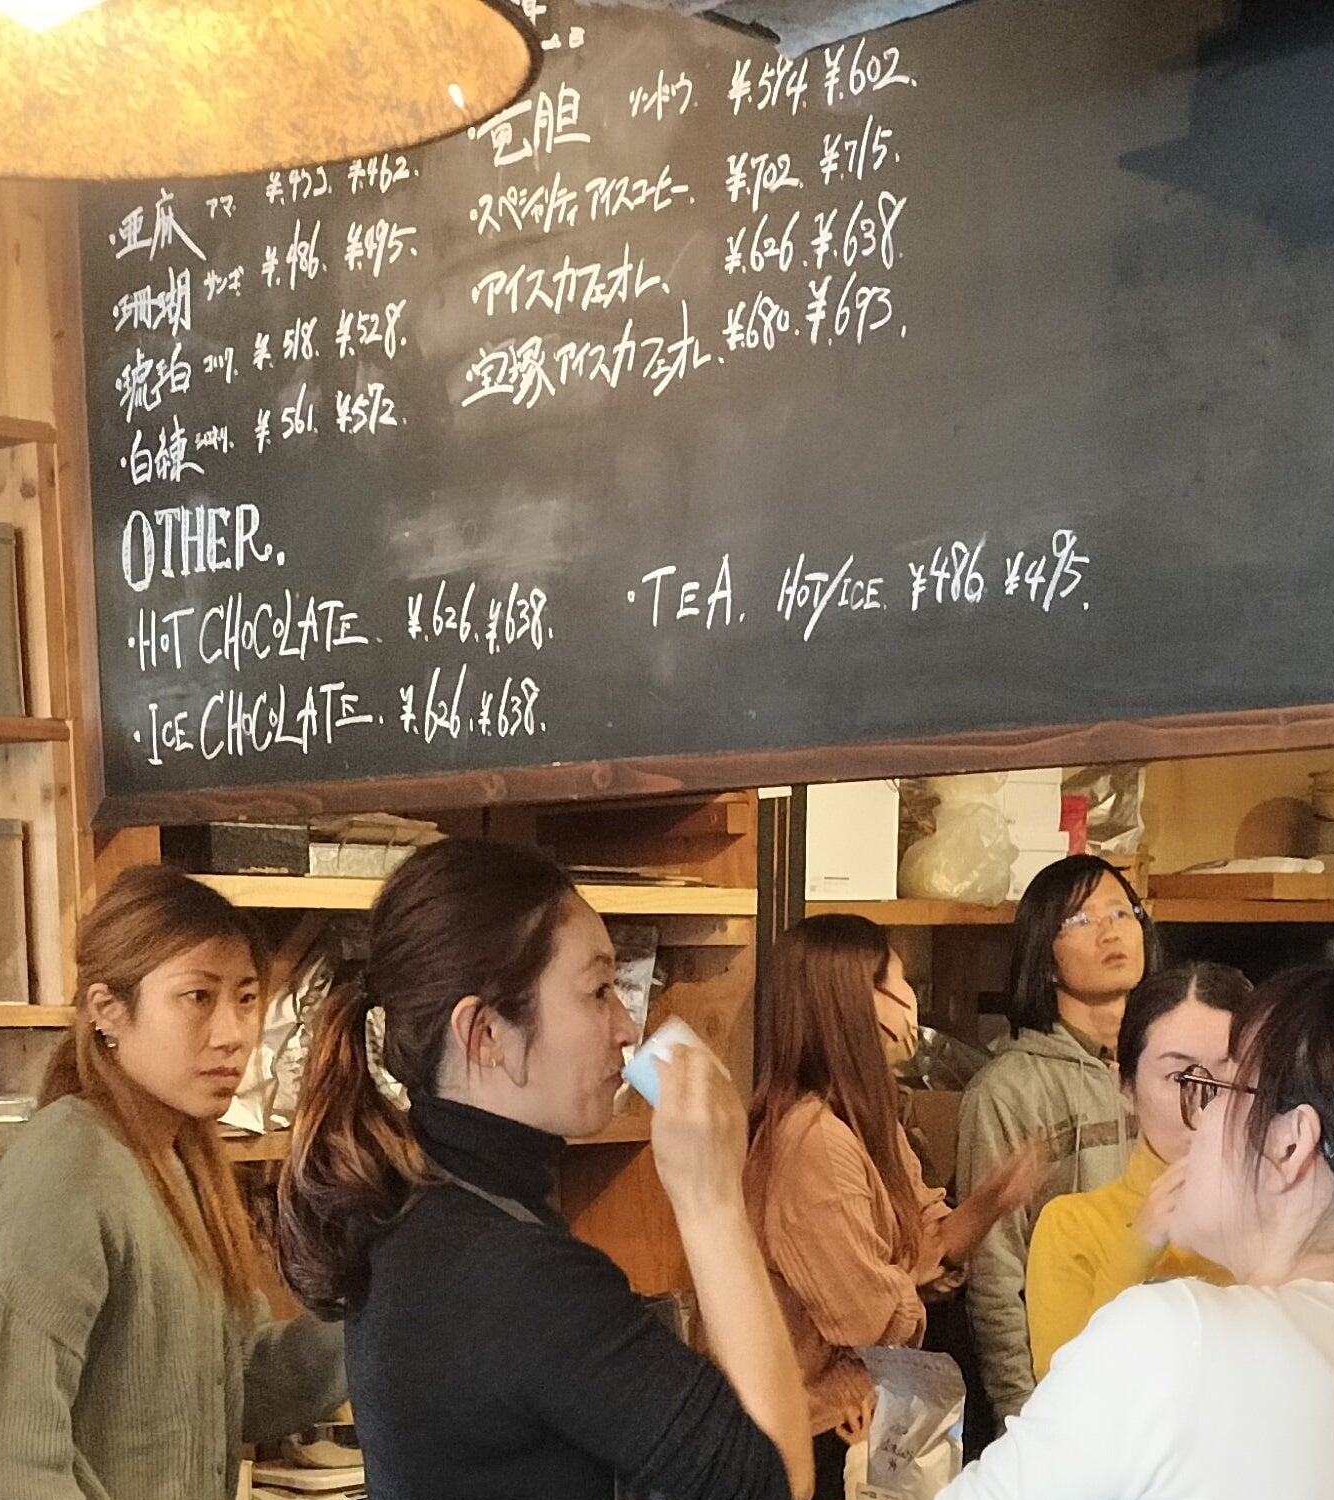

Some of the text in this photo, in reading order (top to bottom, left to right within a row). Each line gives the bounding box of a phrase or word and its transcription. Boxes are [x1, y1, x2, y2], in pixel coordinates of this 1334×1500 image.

[116, 188, 206, 261] 亜麻
[116, 266, 191, 336] 珊瑚
[120, 343, 192, 422] 琥珀
[138, 608, 195, 671] HOT
[147, 702, 194, 765] ICE
